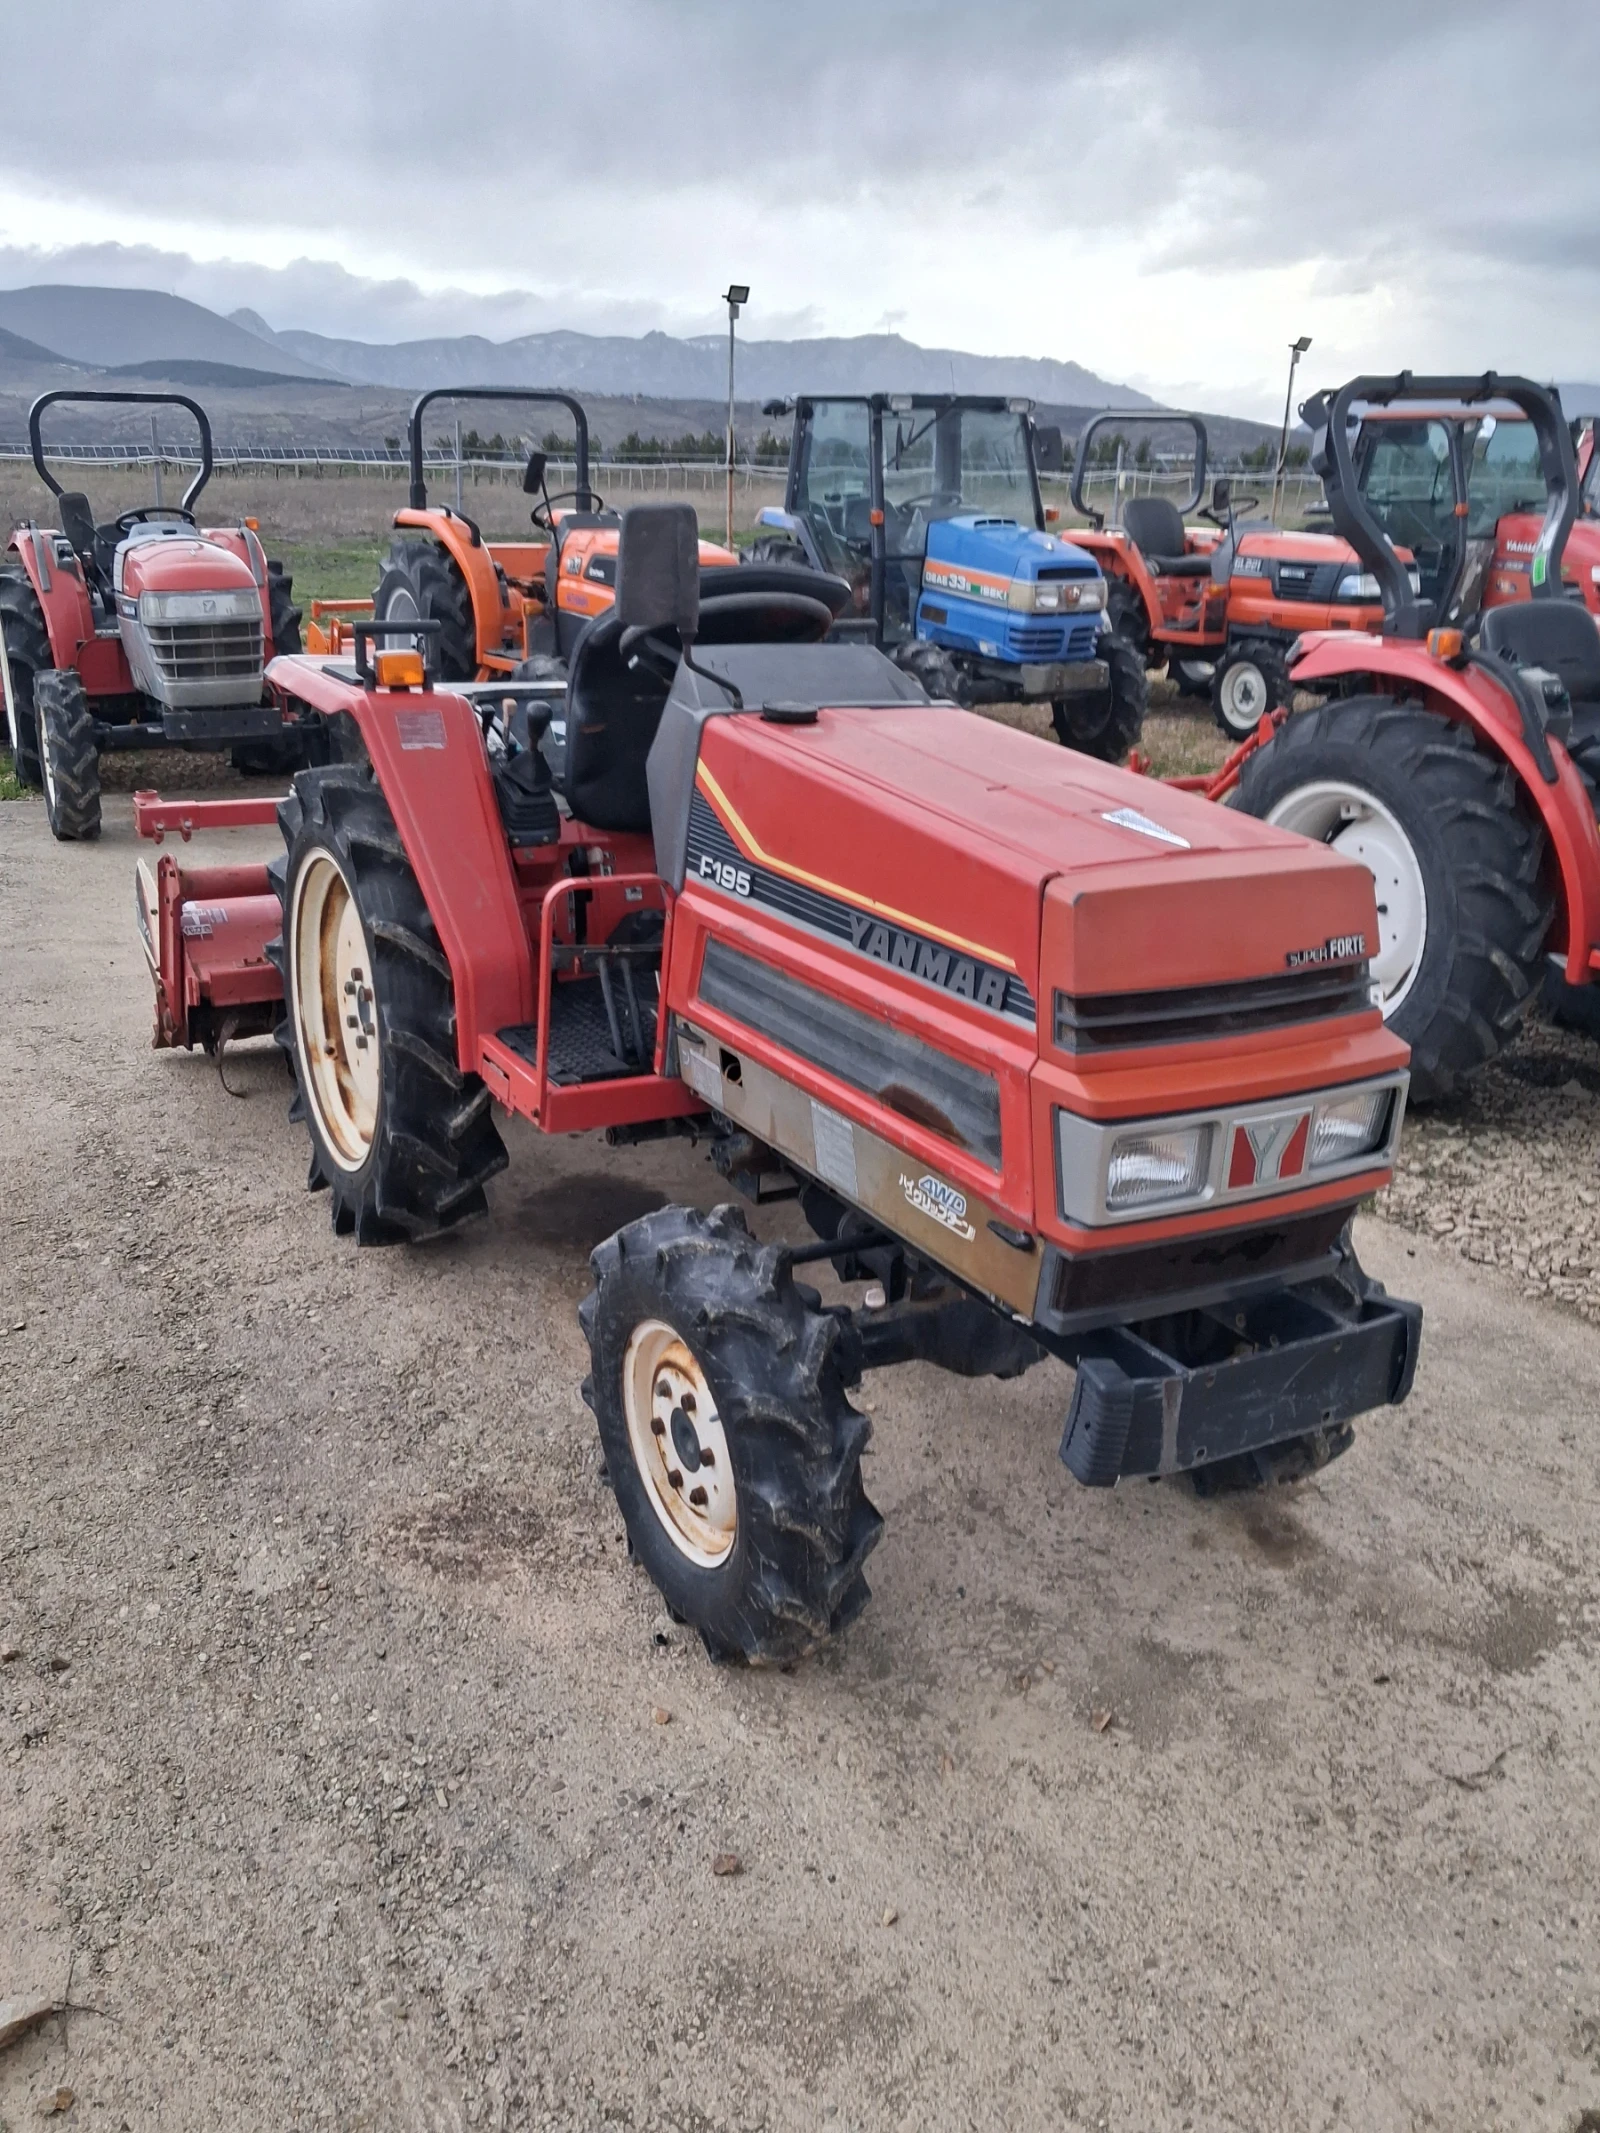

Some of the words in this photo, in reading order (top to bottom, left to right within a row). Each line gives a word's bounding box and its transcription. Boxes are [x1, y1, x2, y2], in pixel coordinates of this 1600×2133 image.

[700, 854, 751, 897] F195
[850, 914, 1009, 1011] YANMAR
[1290, 946, 1328, 967] SUPER
[1329, 934, 1366, 960] FORTE
[919, 1176, 966, 1217] 4WD
